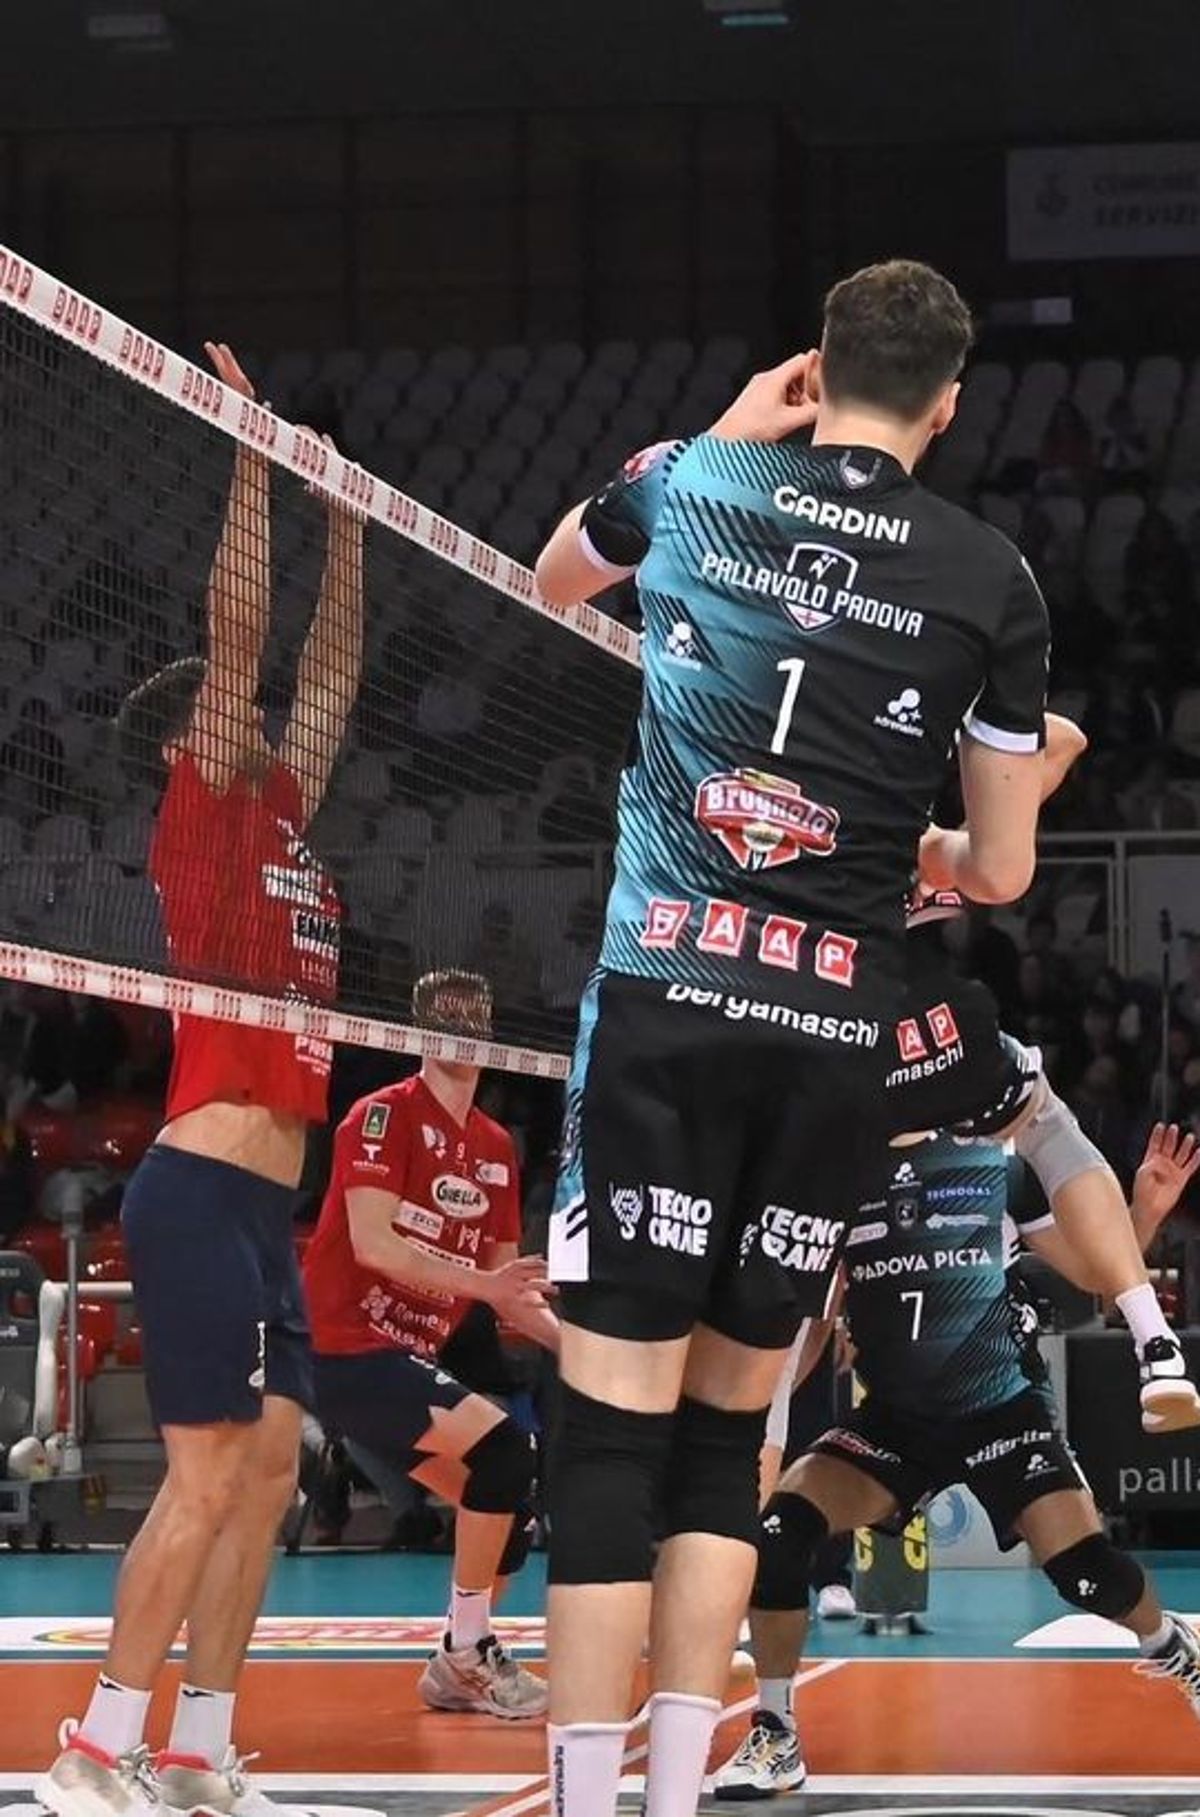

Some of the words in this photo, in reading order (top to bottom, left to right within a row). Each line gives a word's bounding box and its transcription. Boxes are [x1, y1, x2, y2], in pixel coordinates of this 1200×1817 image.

[772, 486, 912, 544] GARDINI
[701, 551, 829, 611] PALLAVOLO
[832, 591, 924, 638] PADOVA
[771, 657, 806, 755] 1
[853, 1254, 929, 1282] PADOVA
[934, 1247, 992, 1269] PICTA
[900, 1291, 924, 1341] 7
